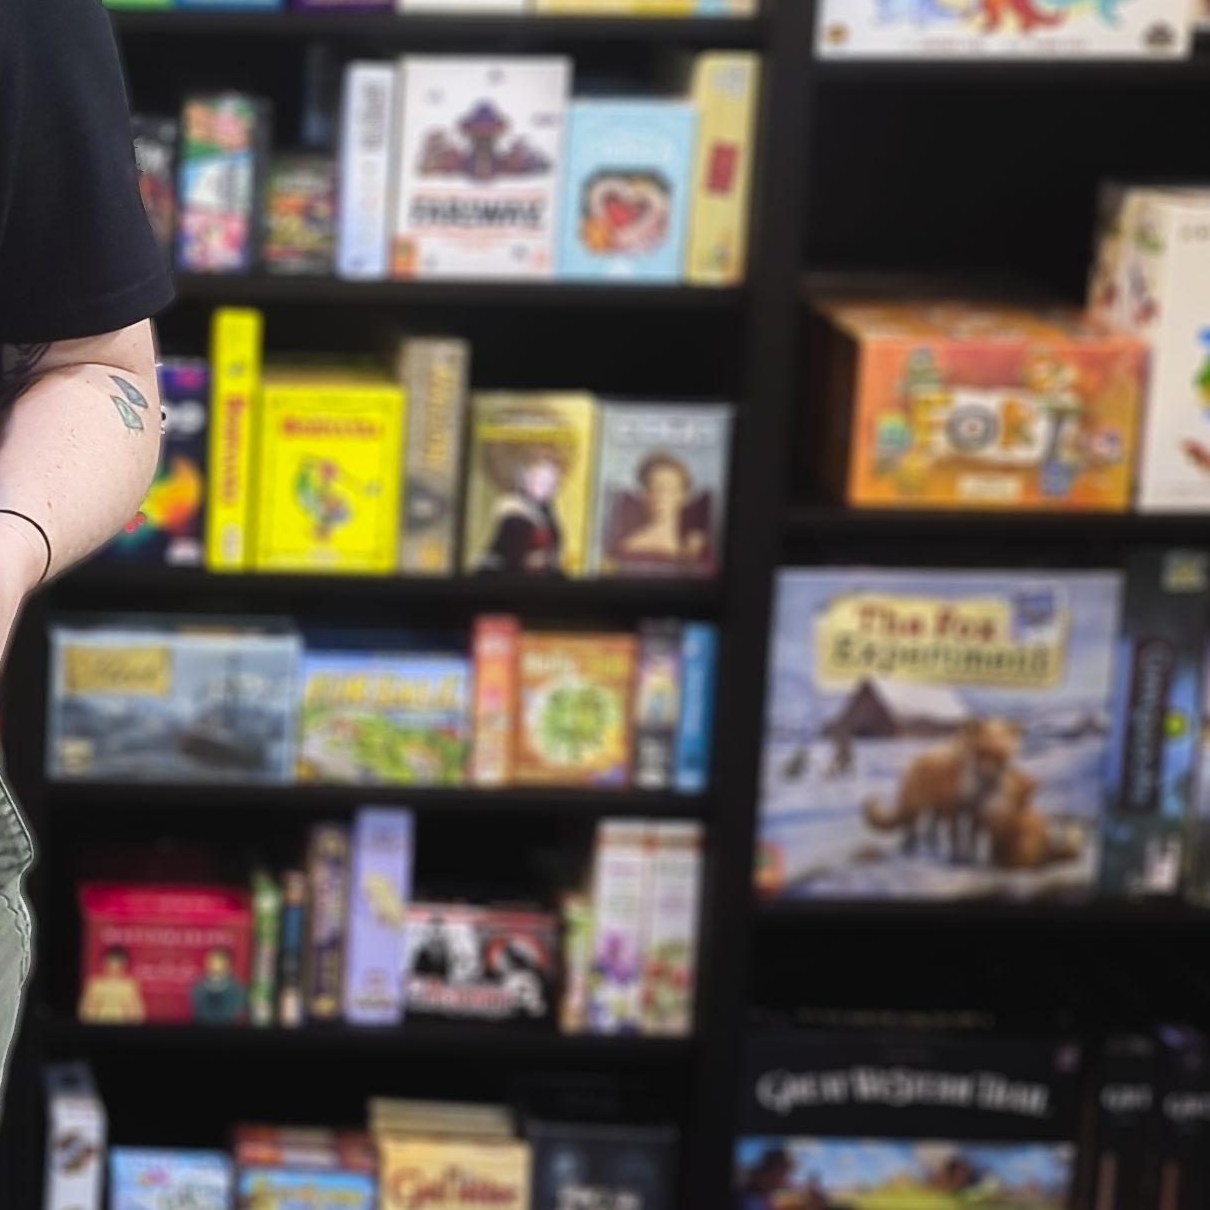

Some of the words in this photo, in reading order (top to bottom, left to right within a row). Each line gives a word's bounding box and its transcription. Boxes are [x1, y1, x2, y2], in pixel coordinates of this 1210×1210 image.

[856, 601, 924, 644] The
[933, 604, 999, 644] Fox
[832, 630, 1052, 675] Experiment
